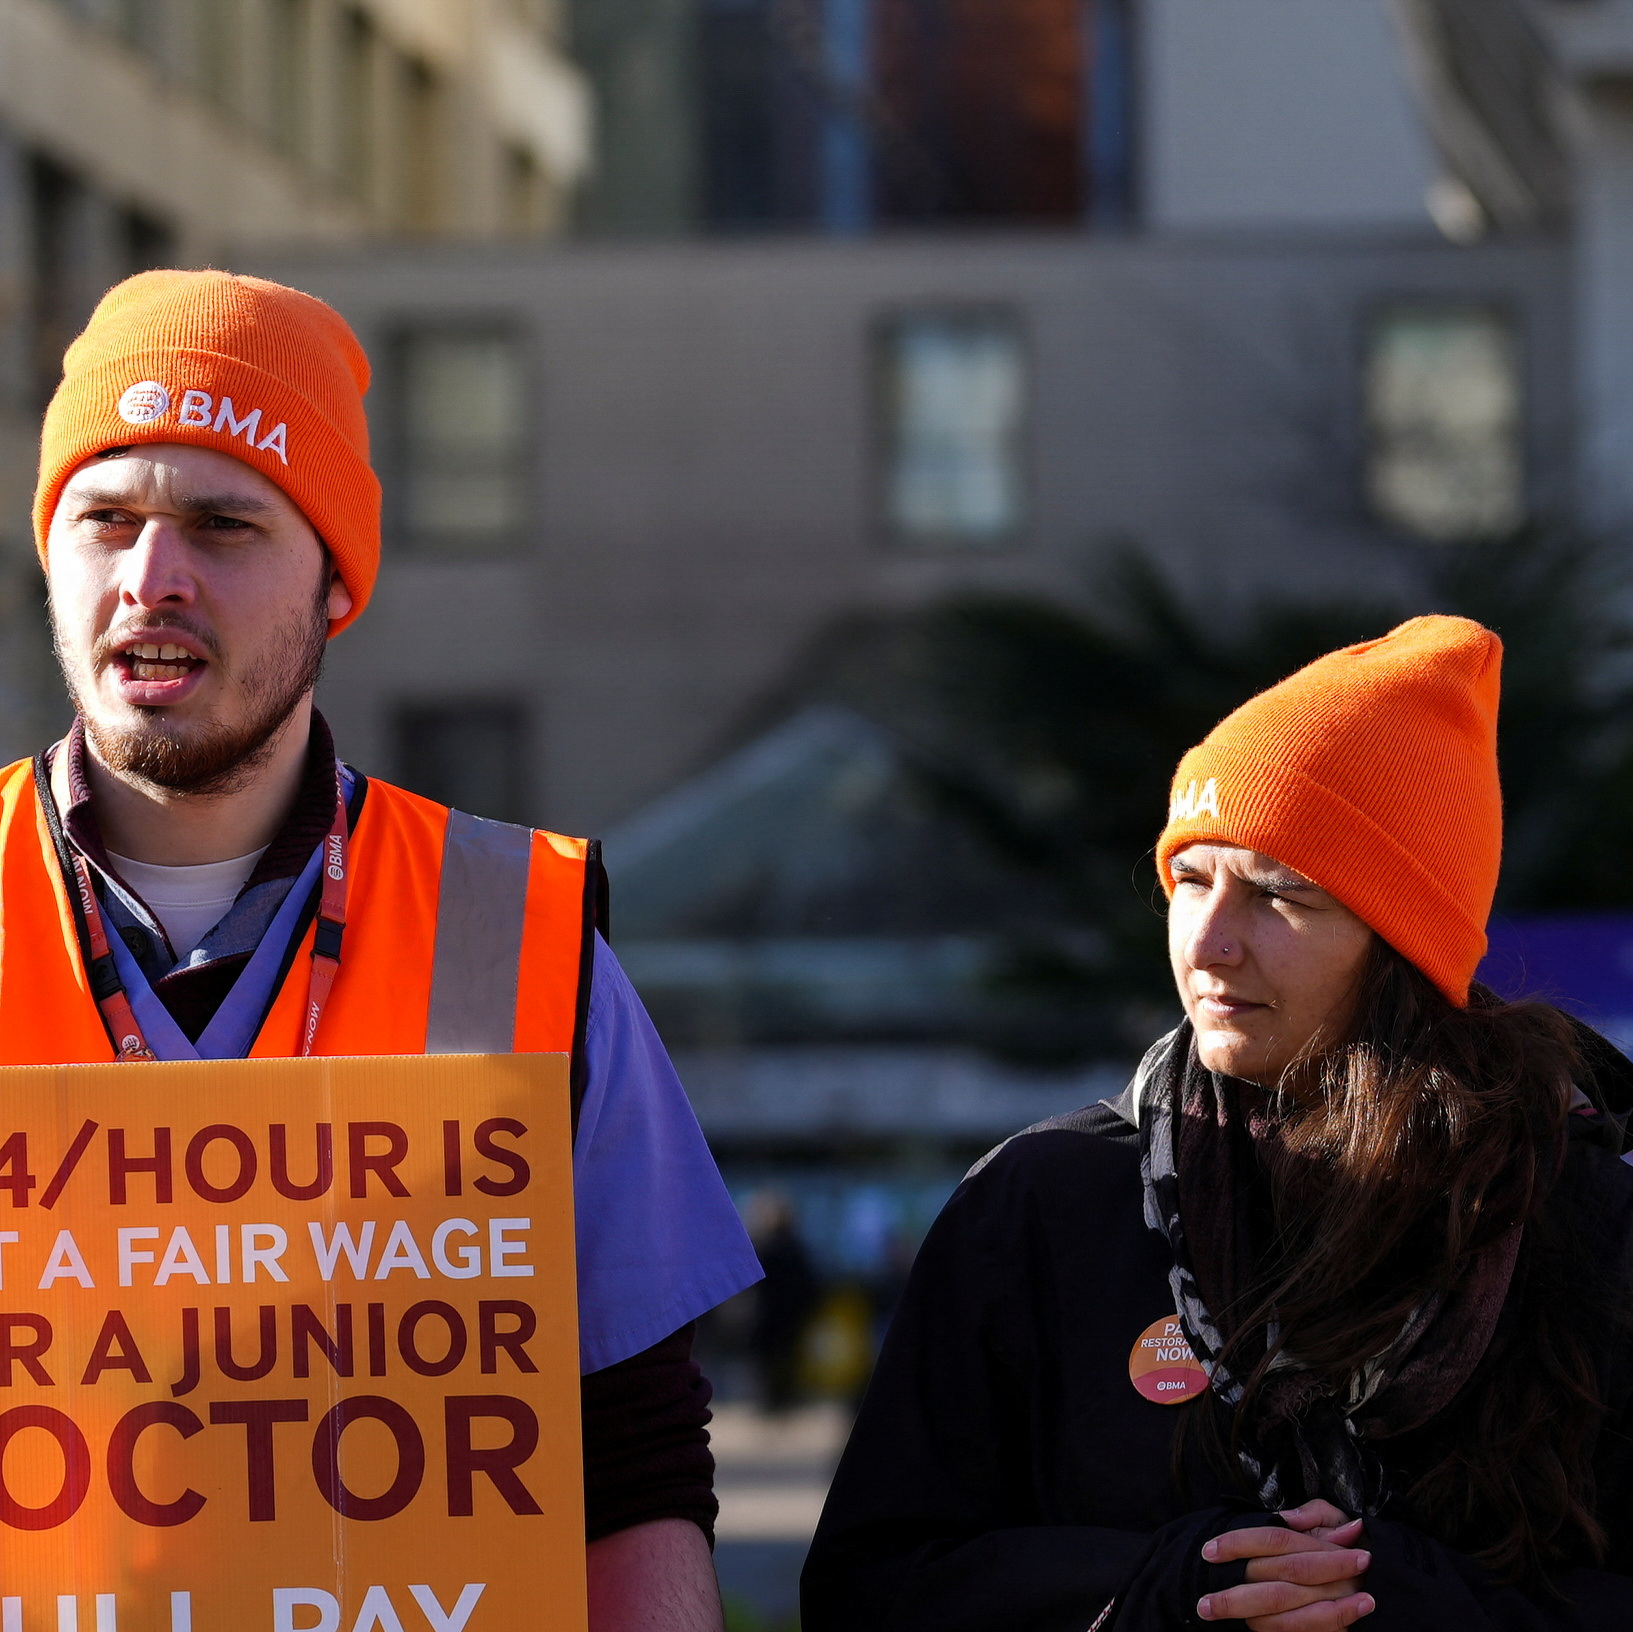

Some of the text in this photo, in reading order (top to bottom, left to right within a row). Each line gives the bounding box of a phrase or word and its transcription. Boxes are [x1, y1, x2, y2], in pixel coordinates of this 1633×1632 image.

[179, 389, 288, 466] BMA
[1169, 777, 1219, 825] MA
[329, 835, 342, 866] BMA
[443, 1117, 532, 1197] IS
[39, 1228, 96, 1290] A
[117, 1222, 290, 1288] FAIR
[308, 1216, 535, 1282] WAGE
[81, 1309, 151, 1386] A
[170, 1299, 540, 1397] JUNIOR
[1156, 1347, 1195, 1361] NOW
[1166, 1381, 1186, 1389] BMA
